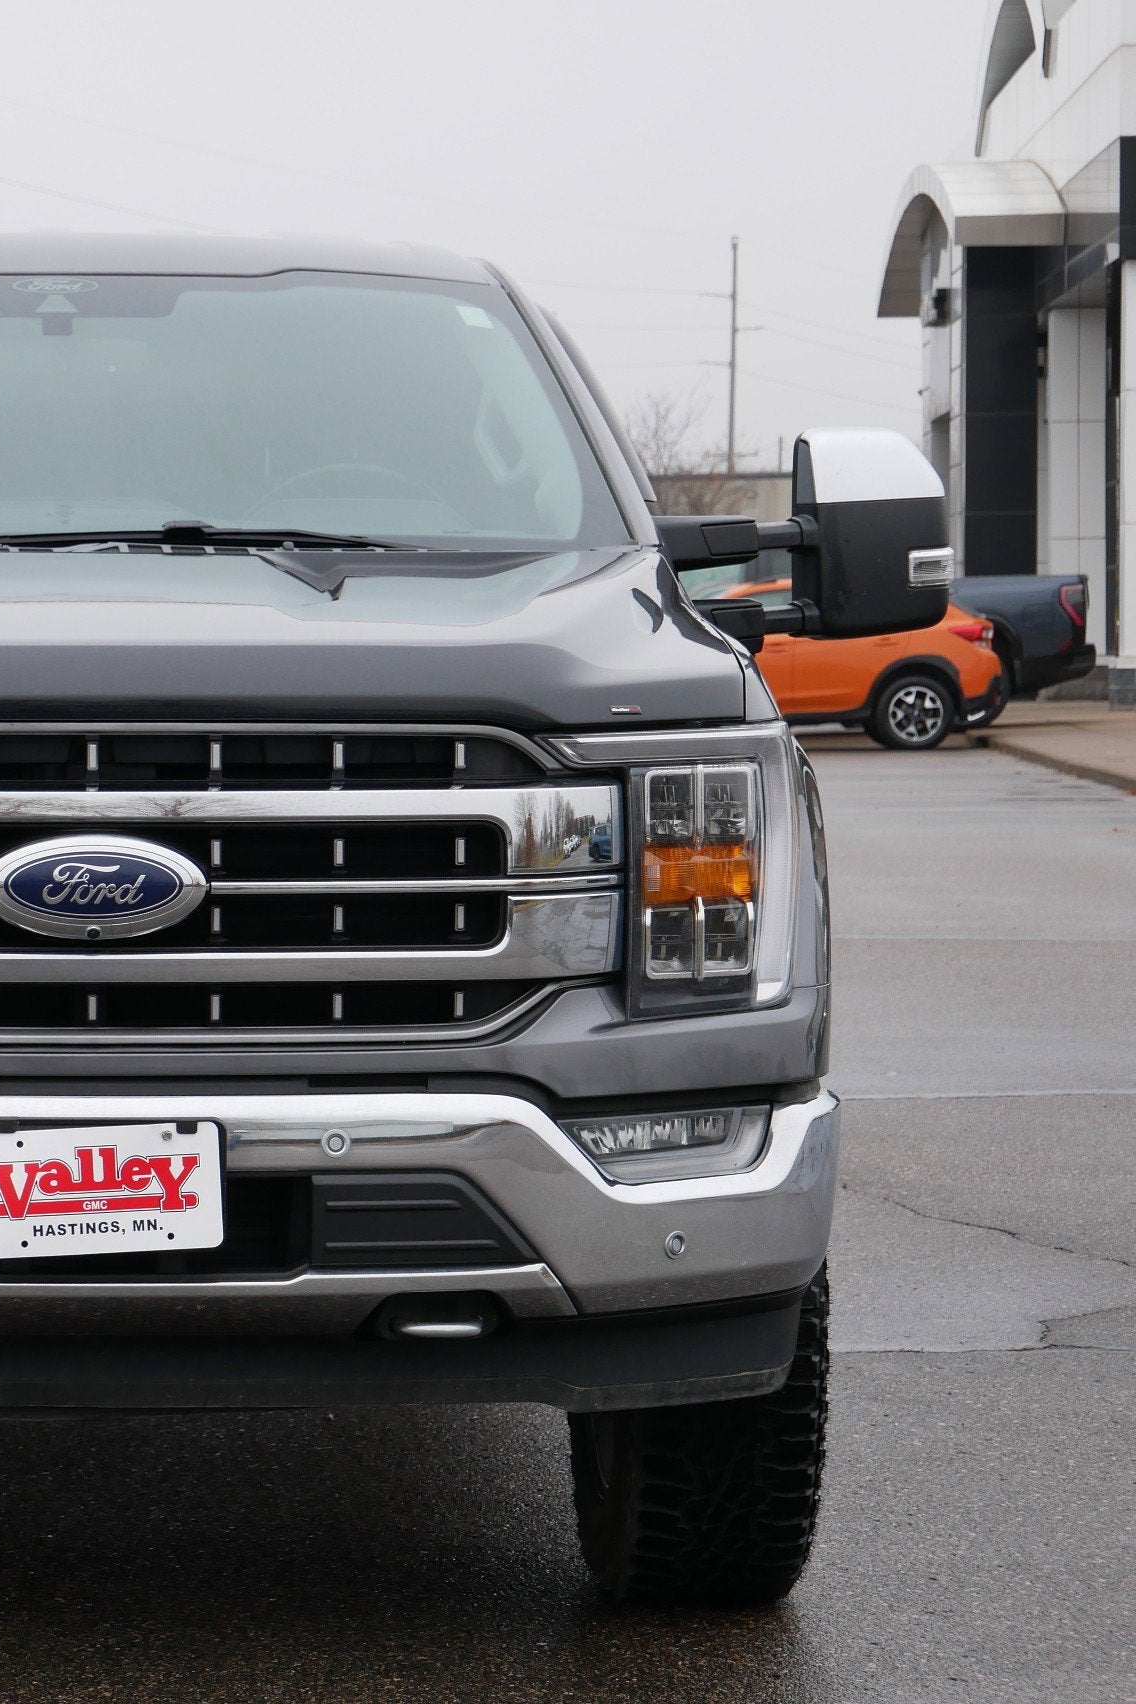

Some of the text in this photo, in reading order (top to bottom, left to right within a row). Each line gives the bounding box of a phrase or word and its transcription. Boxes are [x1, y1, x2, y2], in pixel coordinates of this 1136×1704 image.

[28, 279, 84, 291] Ford
[42, 862, 147, 905] Ford
[82, 1200, 108, 1212] GMC
[32, 1218, 164, 1237] HASTINGS, MN.
